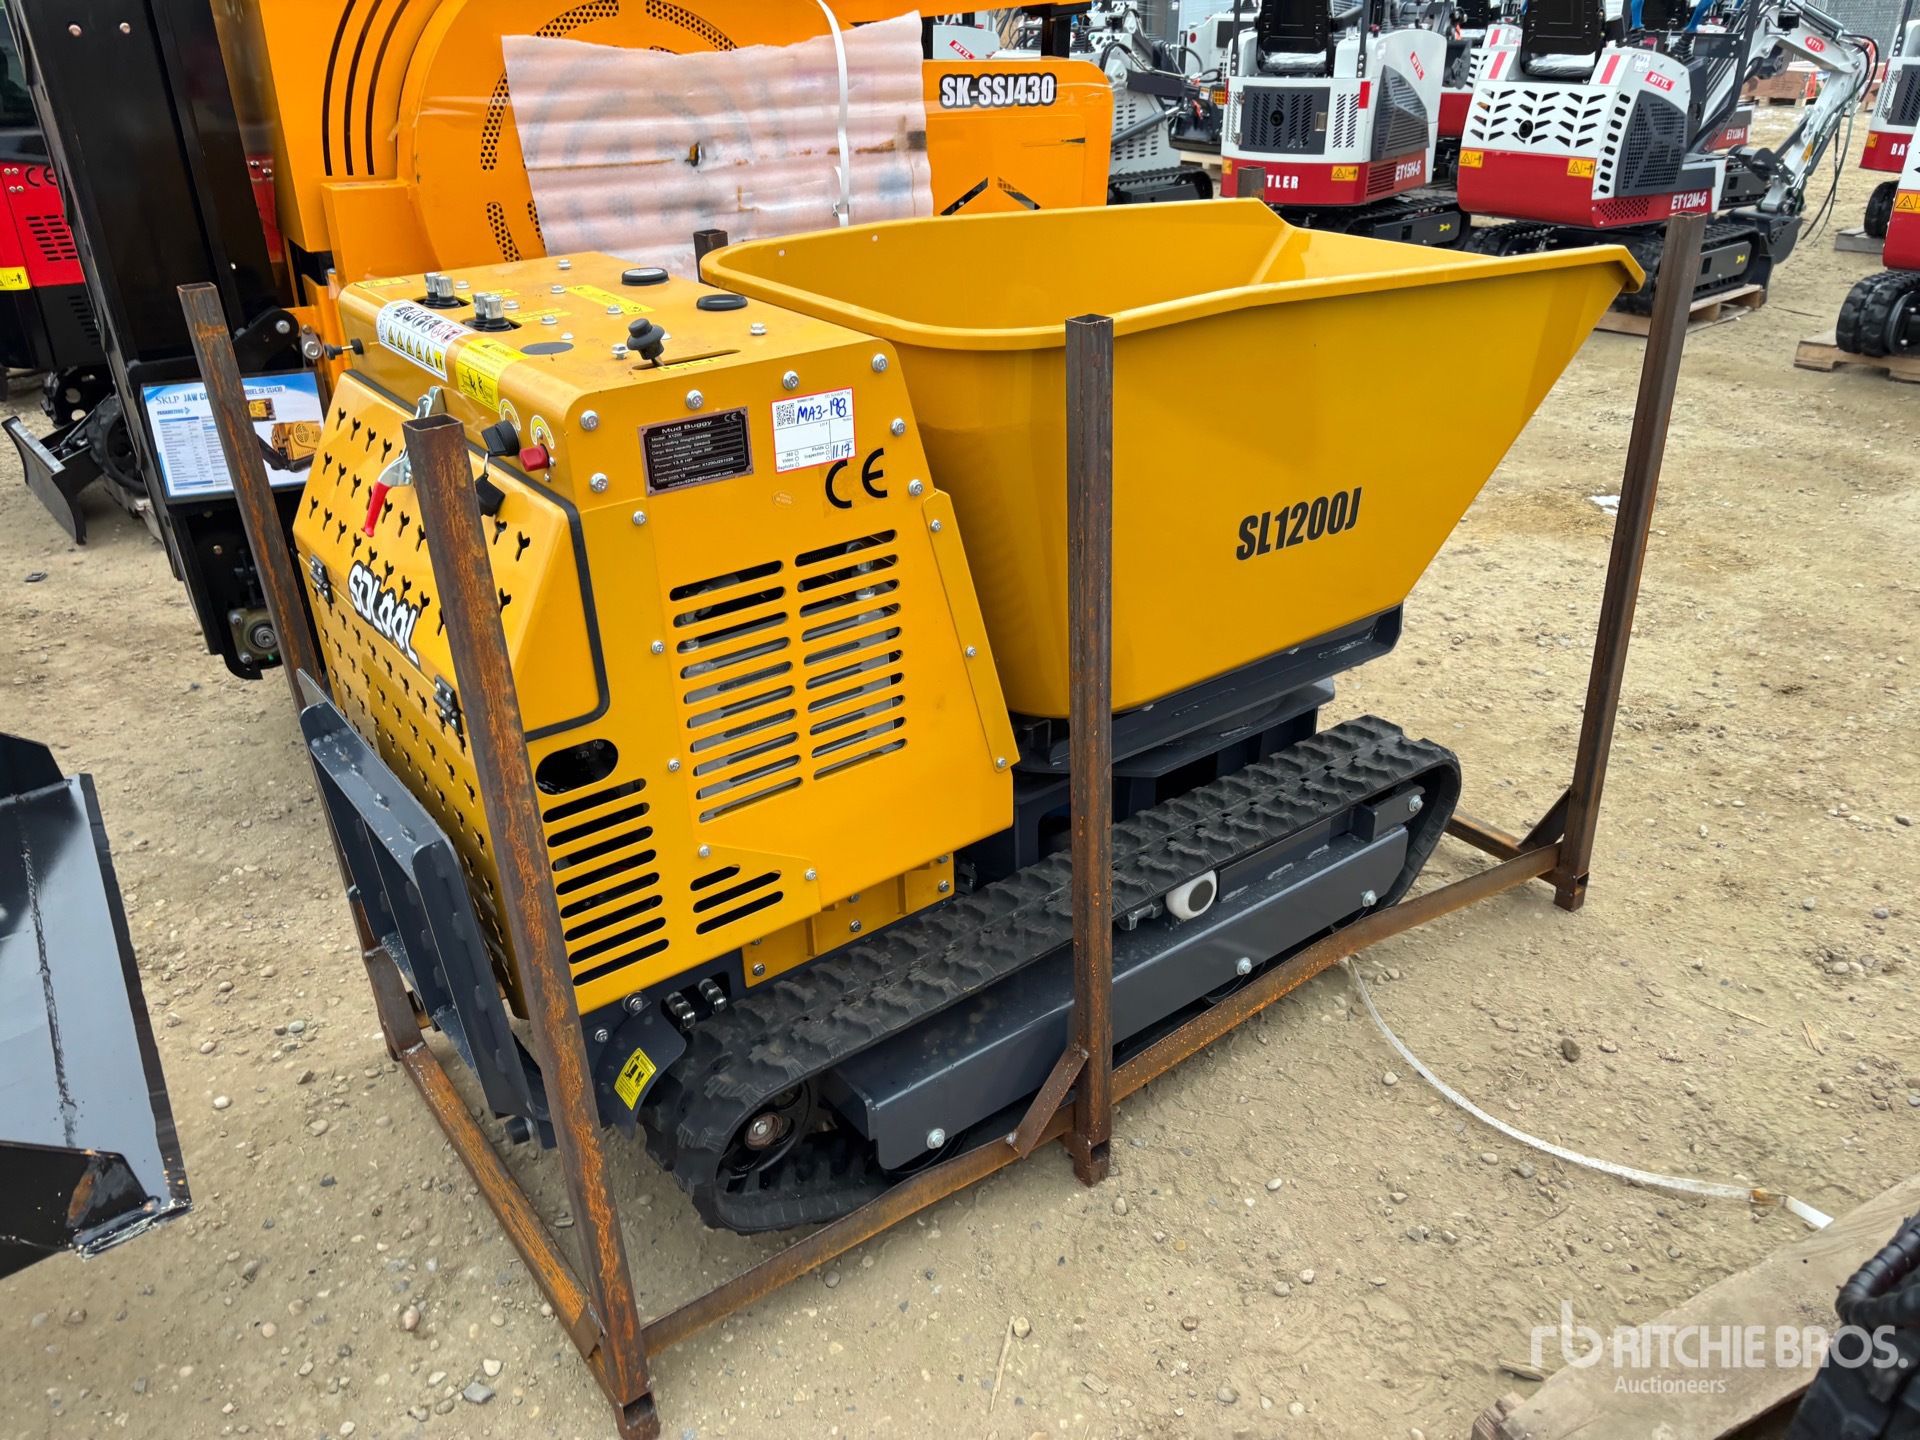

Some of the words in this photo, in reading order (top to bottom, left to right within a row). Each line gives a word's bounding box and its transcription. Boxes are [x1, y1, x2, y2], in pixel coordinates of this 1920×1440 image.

[953, 43, 970, 59] BTTL
[1806, 38, 1822, 50] BTTL
[1412, 56, 1423, 78] BTTL
[1649, 73, 1671, 89] BTTL
[941, 75, 1055, 107] SK-SSJ430
[1890, 142, 1912, 156] BA
[1395, 160, 1421, 182] ET15H-6
[1267, 174, 1298, 189] TLER
[1670, 190, 1707, 211] ET12M-6
[156, 395, 180, 405] SKLP
[796, 397, 846, 425] MA3-198
[661, 426, 681, 434] Mud
[684, 420, 712, 430] Buggy
[825, 447, 888, 509] CE
[1236, 486, 1362, 561] SL1200J
